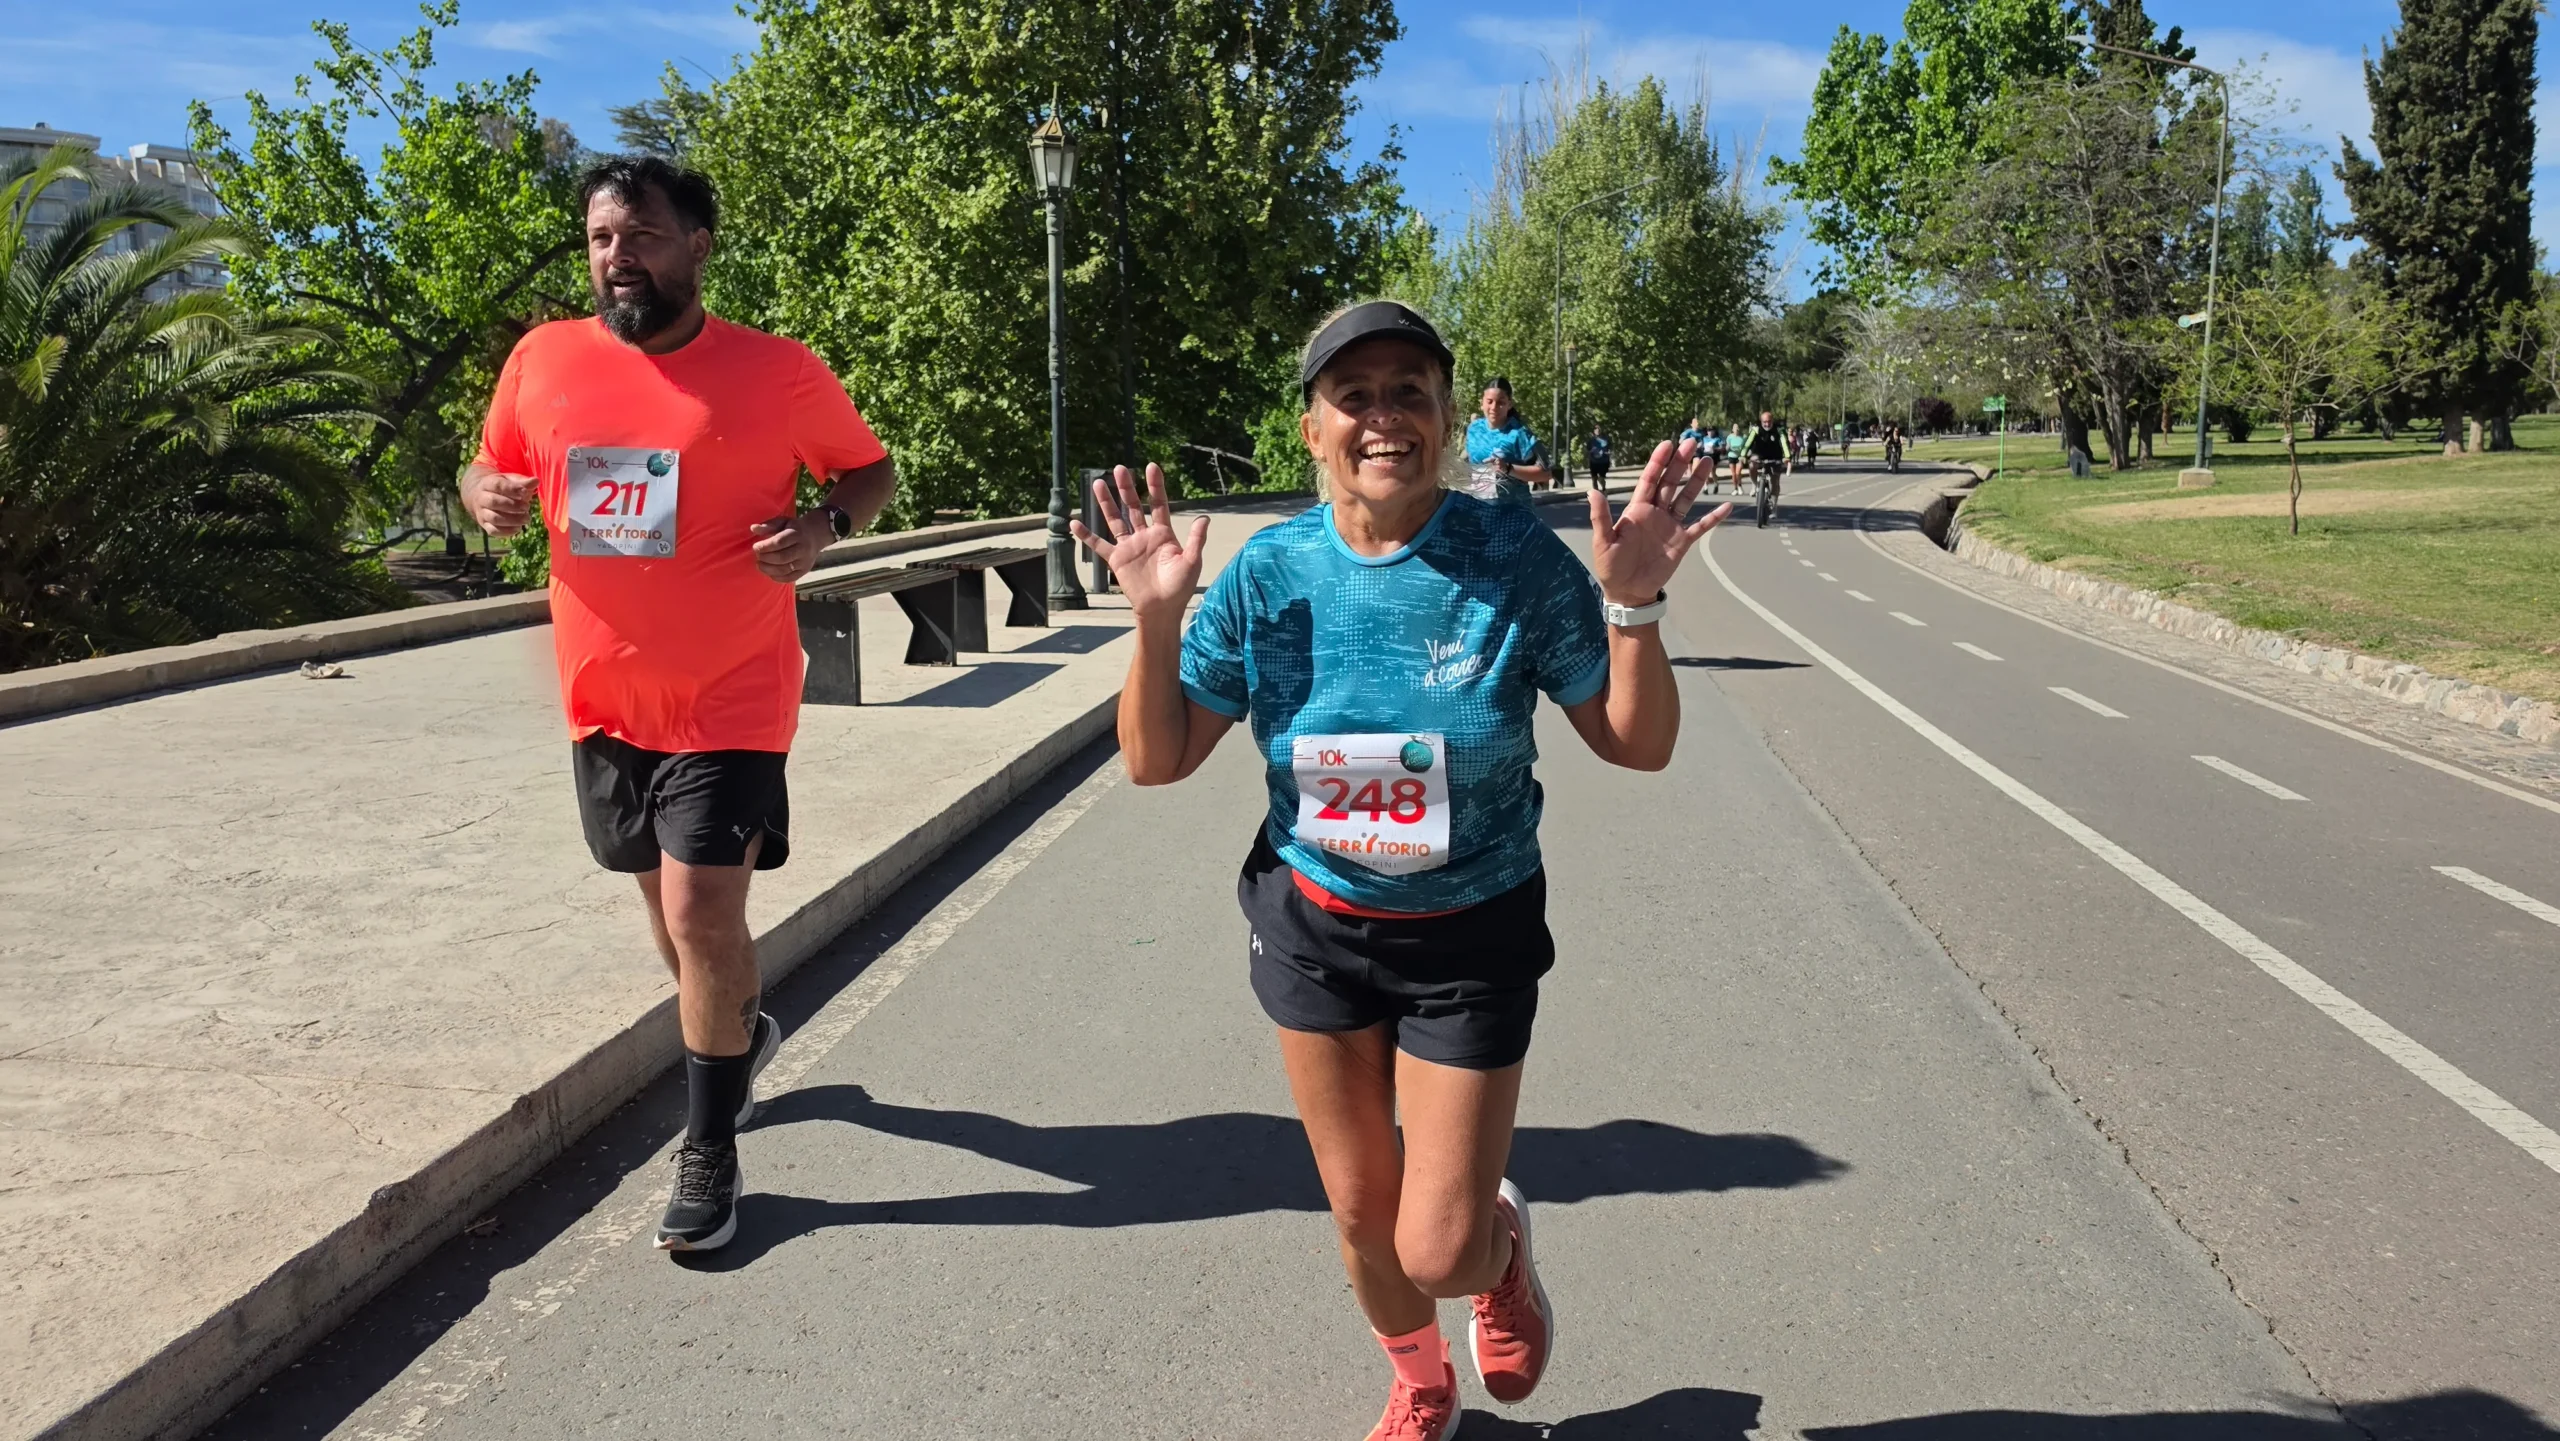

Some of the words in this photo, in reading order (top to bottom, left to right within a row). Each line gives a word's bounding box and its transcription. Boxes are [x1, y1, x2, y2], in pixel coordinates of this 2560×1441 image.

[586, 456, 609, 469] 10k
[590, 479, 649, 517] 211
[581, 523, 663, 539] TERRITORIO
[1317, 749, 1348, 766] 10k
[1313, 777, 1427, 824] 248
[1316, 832, 1431, 857] TERRITORIO
